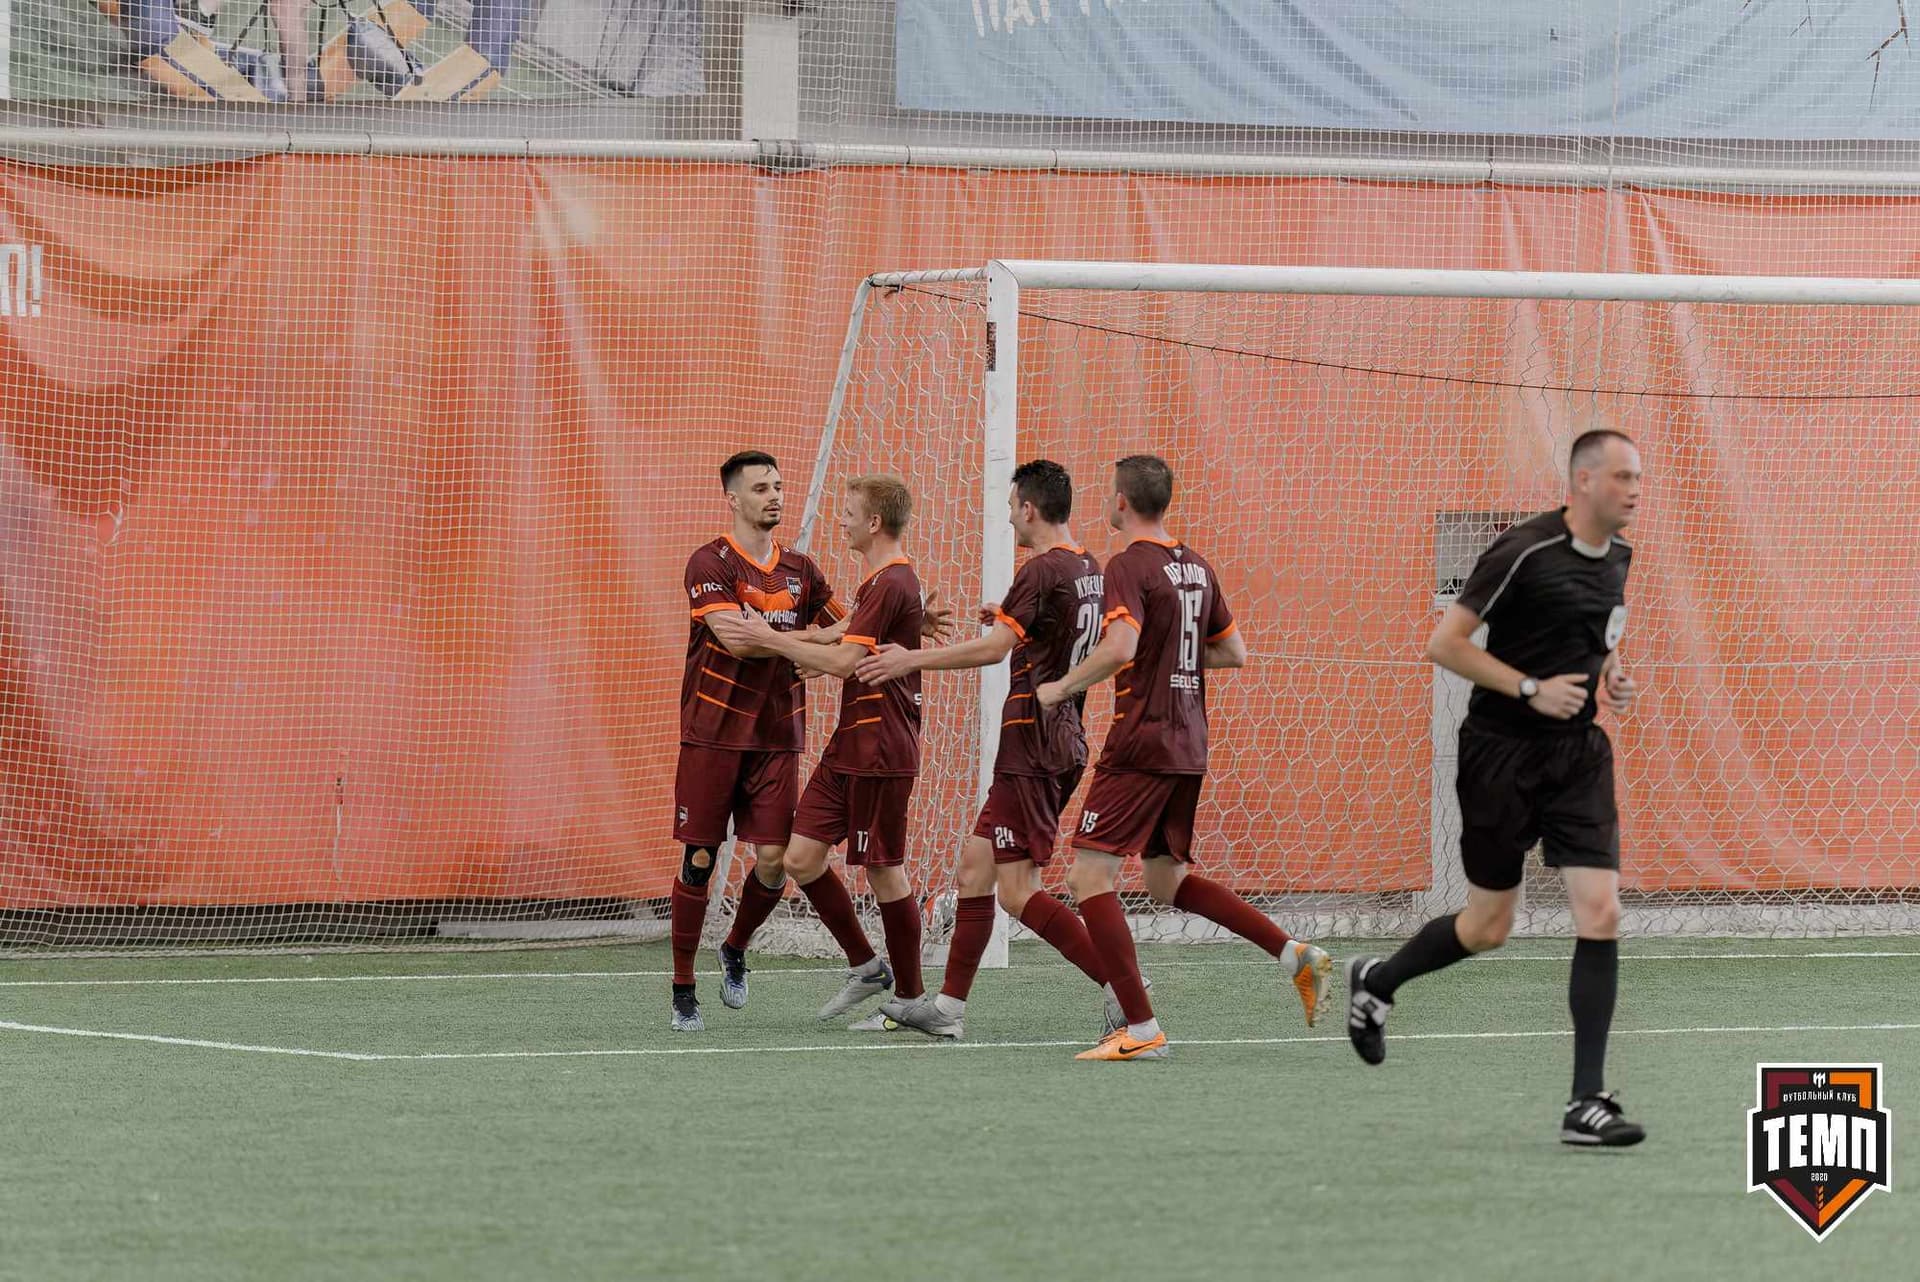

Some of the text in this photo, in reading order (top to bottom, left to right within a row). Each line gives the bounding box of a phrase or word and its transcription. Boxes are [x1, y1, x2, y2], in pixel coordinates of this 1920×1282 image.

[1178, 589, 1203, 671] 15
[1080, 810, 1099, 833] 15
[857, 830, 869, 853] 17
[994, 826, 1015, 849] 24
